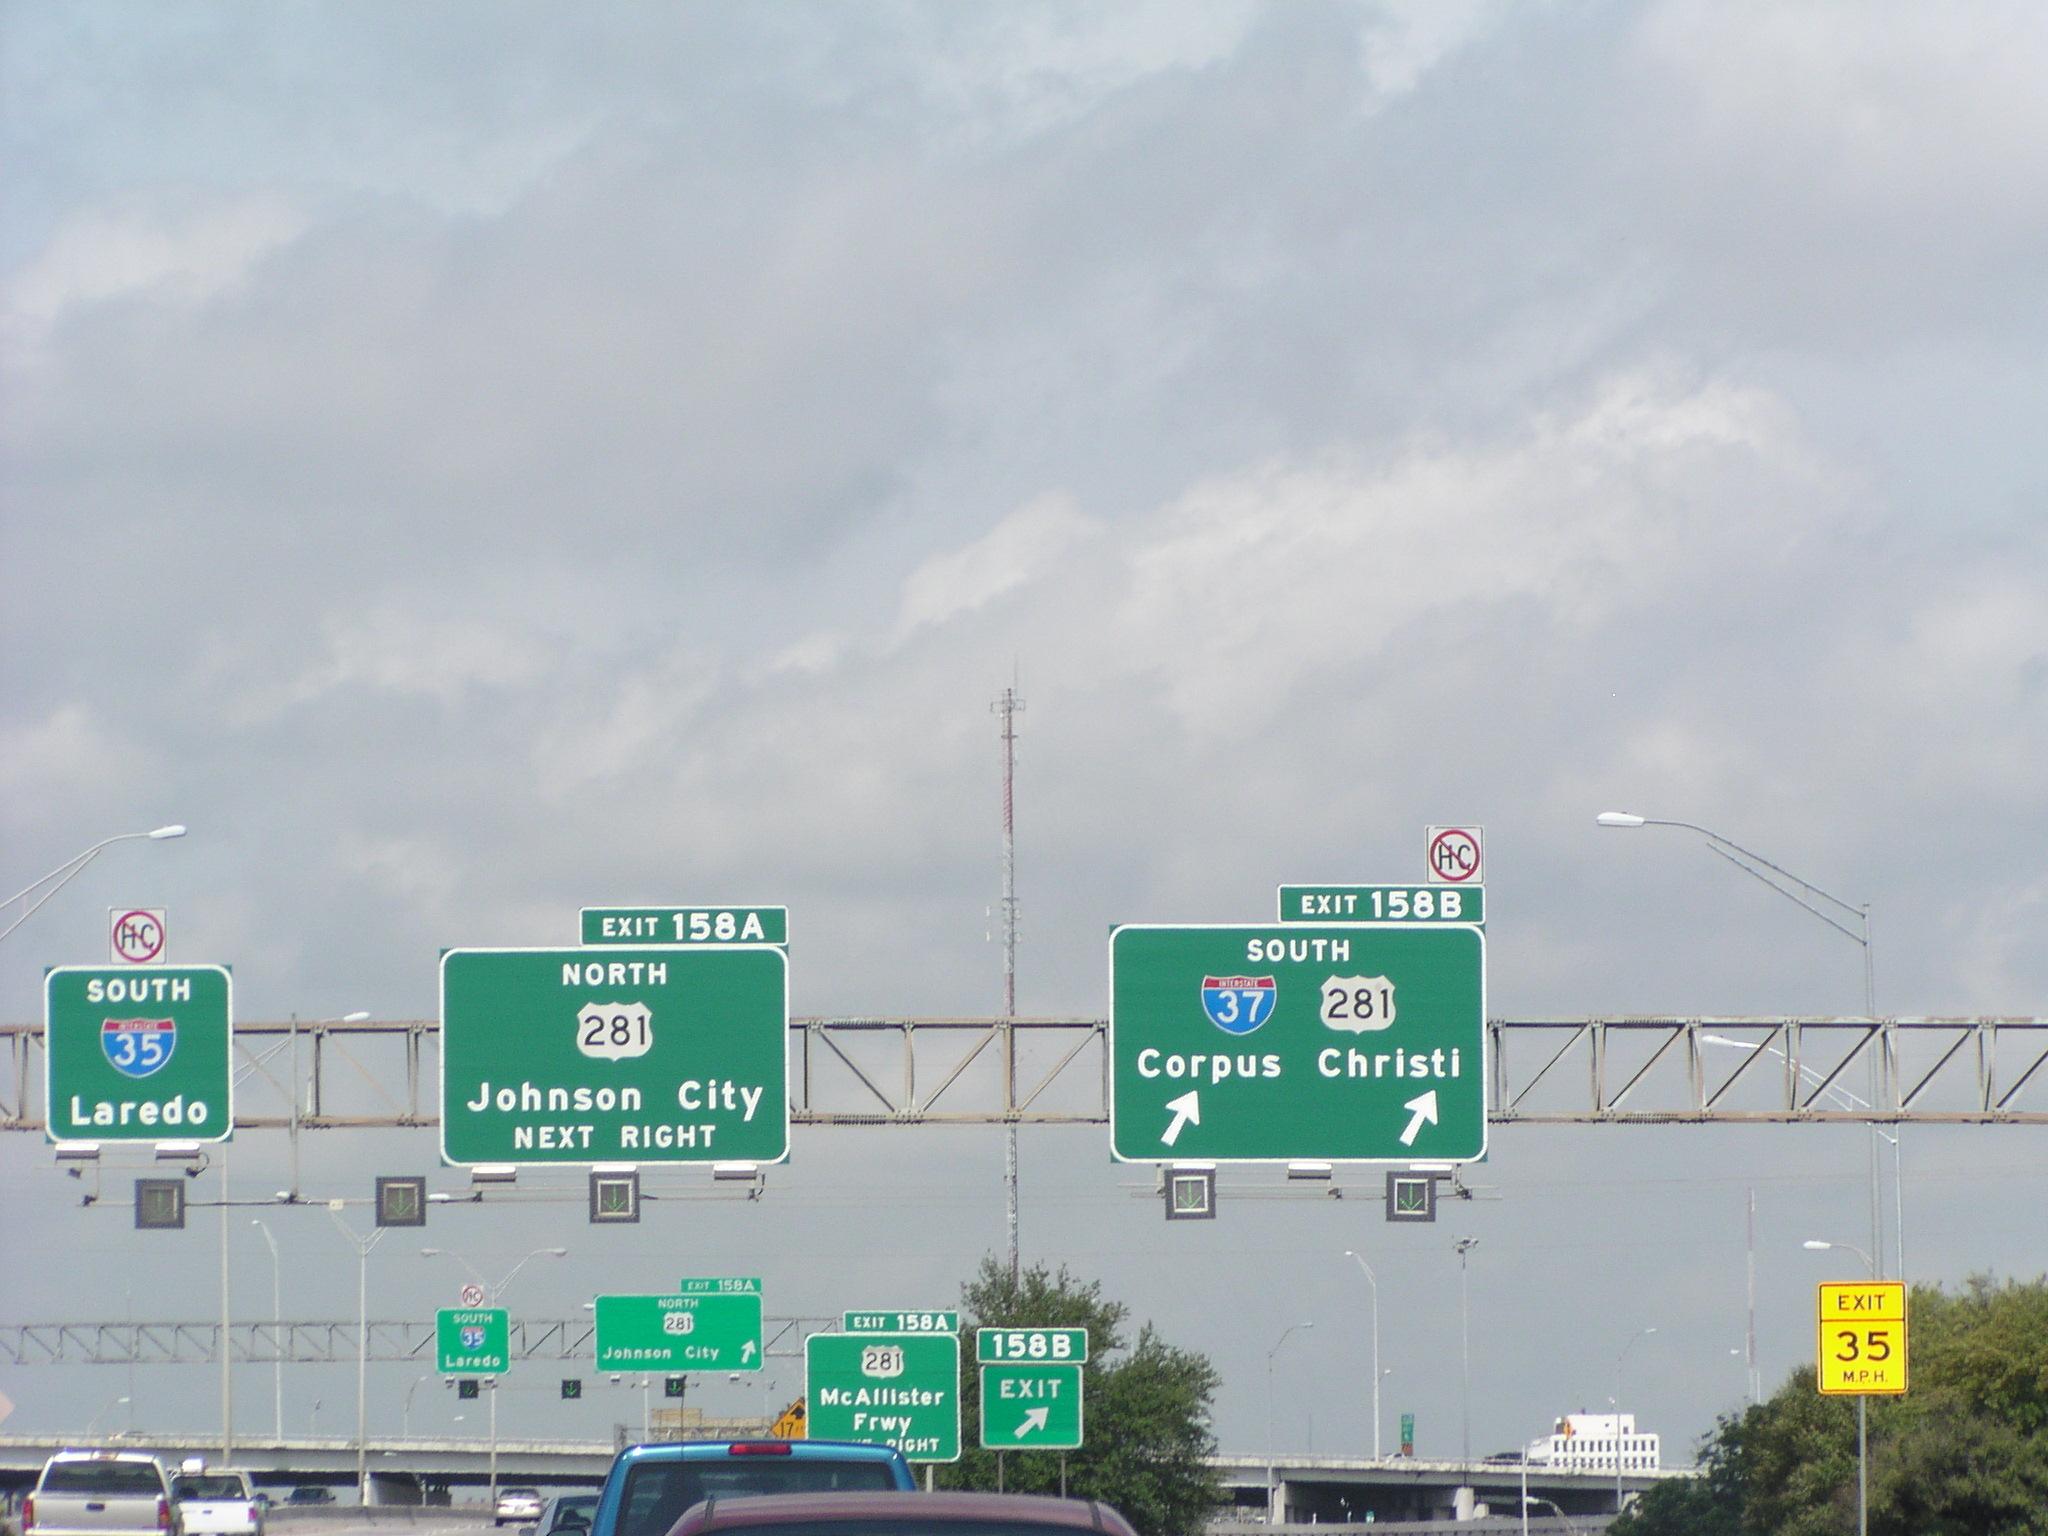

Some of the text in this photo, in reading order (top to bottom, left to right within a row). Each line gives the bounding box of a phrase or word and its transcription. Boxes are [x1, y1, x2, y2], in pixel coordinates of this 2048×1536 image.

[1301, 890, 1463, 919] EXIT 158B
[602, 912, 766, 940] EXIT 158A
[1246, 939, 1350, 962] SOUTH
[562, 962, 667, 985] NORTH
[87, 978, 191, 1003] SOUTH
[1217, 990, 1264, 1023] 37
[1327, 988, 1390, 1019] 281
[584, 1015, 646, 1046] 281
[114, 1033, 163, 1066] 35
[1137, 1048, 1461, 1084] Corpus Christi
[71, 1095, 208, 1126] Laredo
[467, 1079, 764, 1122] Johnson City
[514, 1125, 717, 1149] NEXT RIGHT
[687, 1280, 755, 1291] EXIT 158A
[658, 1299, 699, 1309] NORTH
[1838, 1294, 1886, 1311] EXIT
[453, 1313, 493, 1323] SOUTH
[666, 1317, 691, 1331] 281
[853, 1314, 949, 1331] EXIT 158A
[463, 1332, 485, 1347] 35
[992, 1333, 1072, 1359] 158B
[1836, 1331, 1890, 1362] 35
[445, 1354, 501, 1368] Laredo
[602, 1345, 720, 1361] Johnson City
[865, 1352, 901, 1371] 281
[820, 1388, 945, 1406] McAllister
[1000, 1379, 1062, 1399] EXIT
[853, 1413, 912, 1437] Frwy
